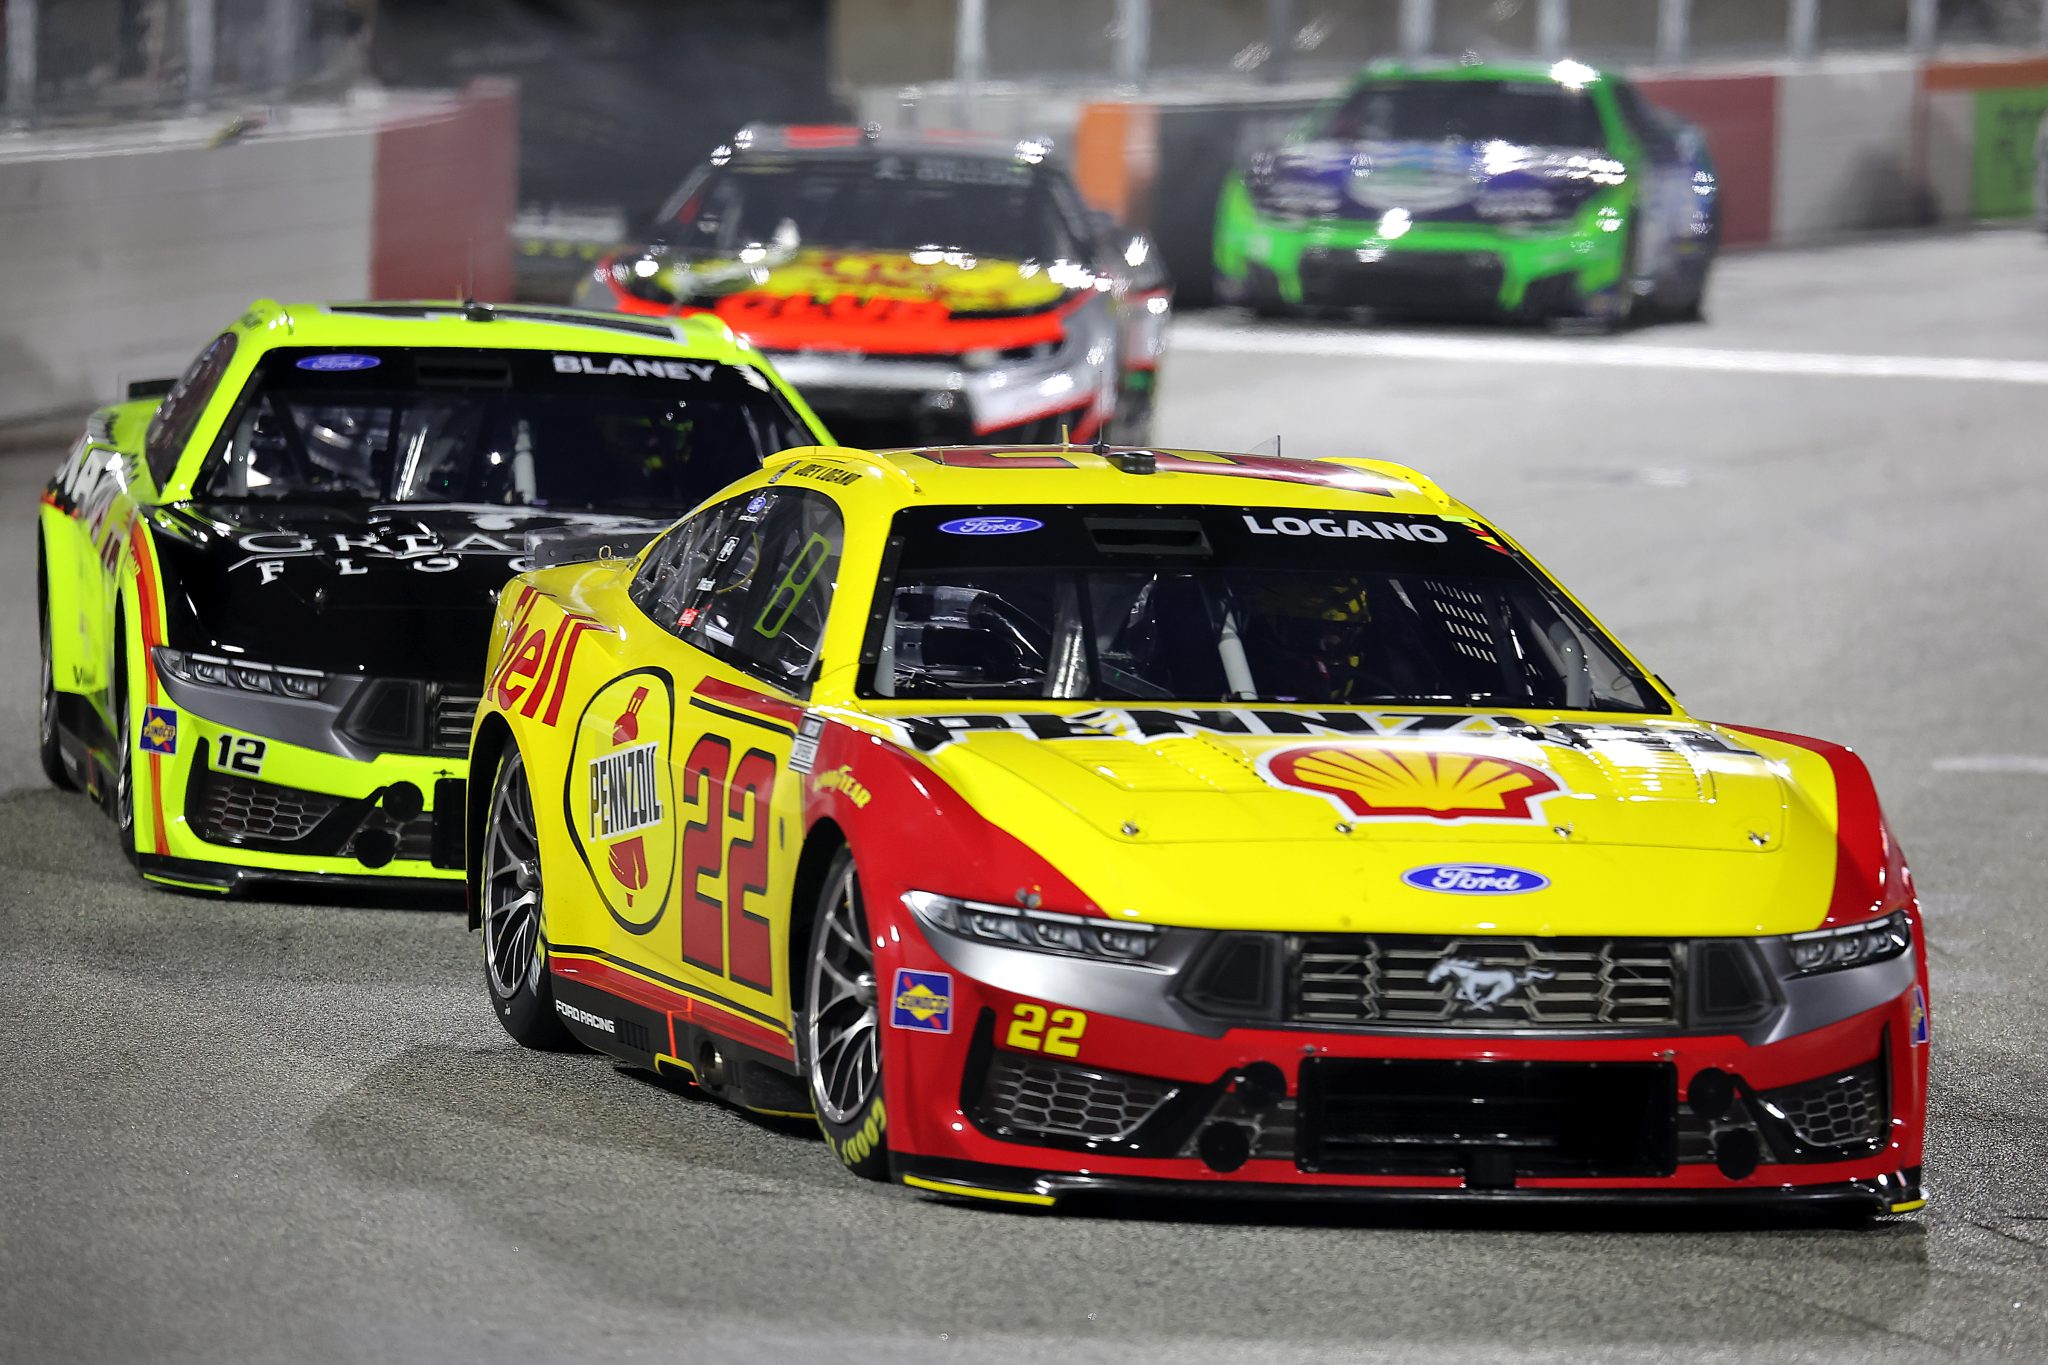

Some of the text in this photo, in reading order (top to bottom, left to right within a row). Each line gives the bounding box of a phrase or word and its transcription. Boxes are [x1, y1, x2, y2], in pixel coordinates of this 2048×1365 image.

[553, 354, 715, 382] BLANEY
[1242, 515, 1449, 543] LOGANO
[216, 733, 267, 776] 12
[588, 742, 663, 842] PENNZOIL
[681, 732, 774, 996] 22
[1431, 866, 1522, 891] Ford
[555, 999, 616, 1034] FORD RACING
[1006, 1002, 1088, 1058] 22
